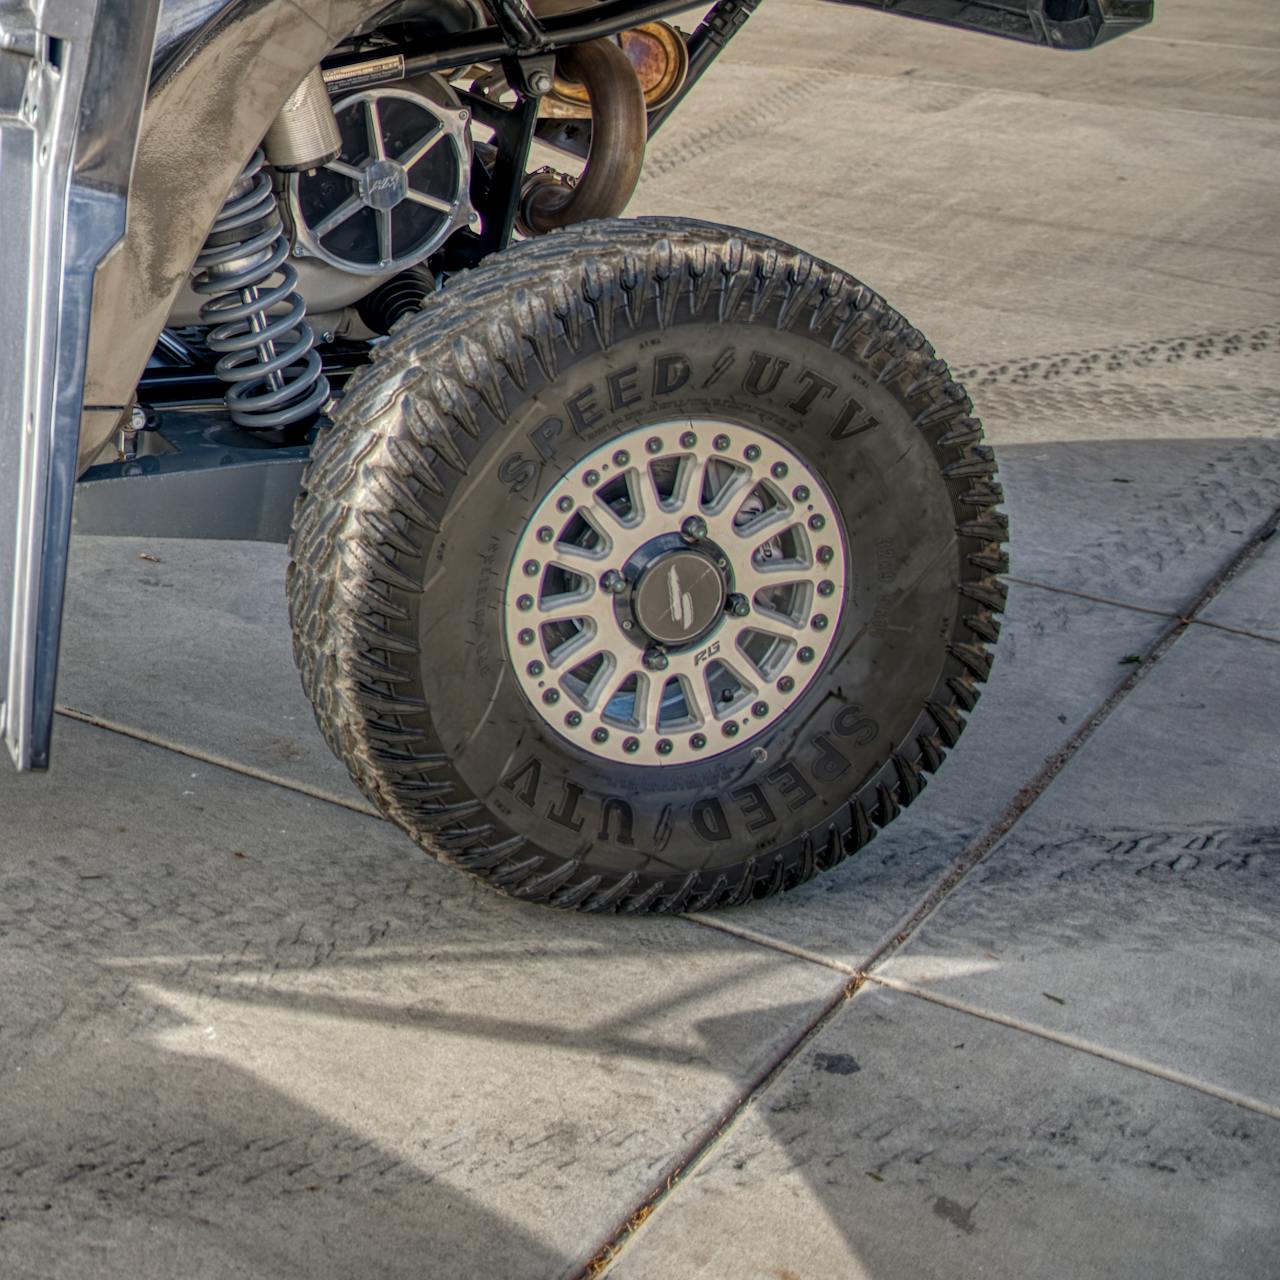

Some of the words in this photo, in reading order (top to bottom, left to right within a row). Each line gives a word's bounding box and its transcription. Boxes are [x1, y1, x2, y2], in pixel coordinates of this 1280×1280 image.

[498, 352, 692, 492] SPEED
[743, 351, 879, 441] UTV
[501, 755, 634, 846] UTV
[689, 705, 880, 842] SPEED
